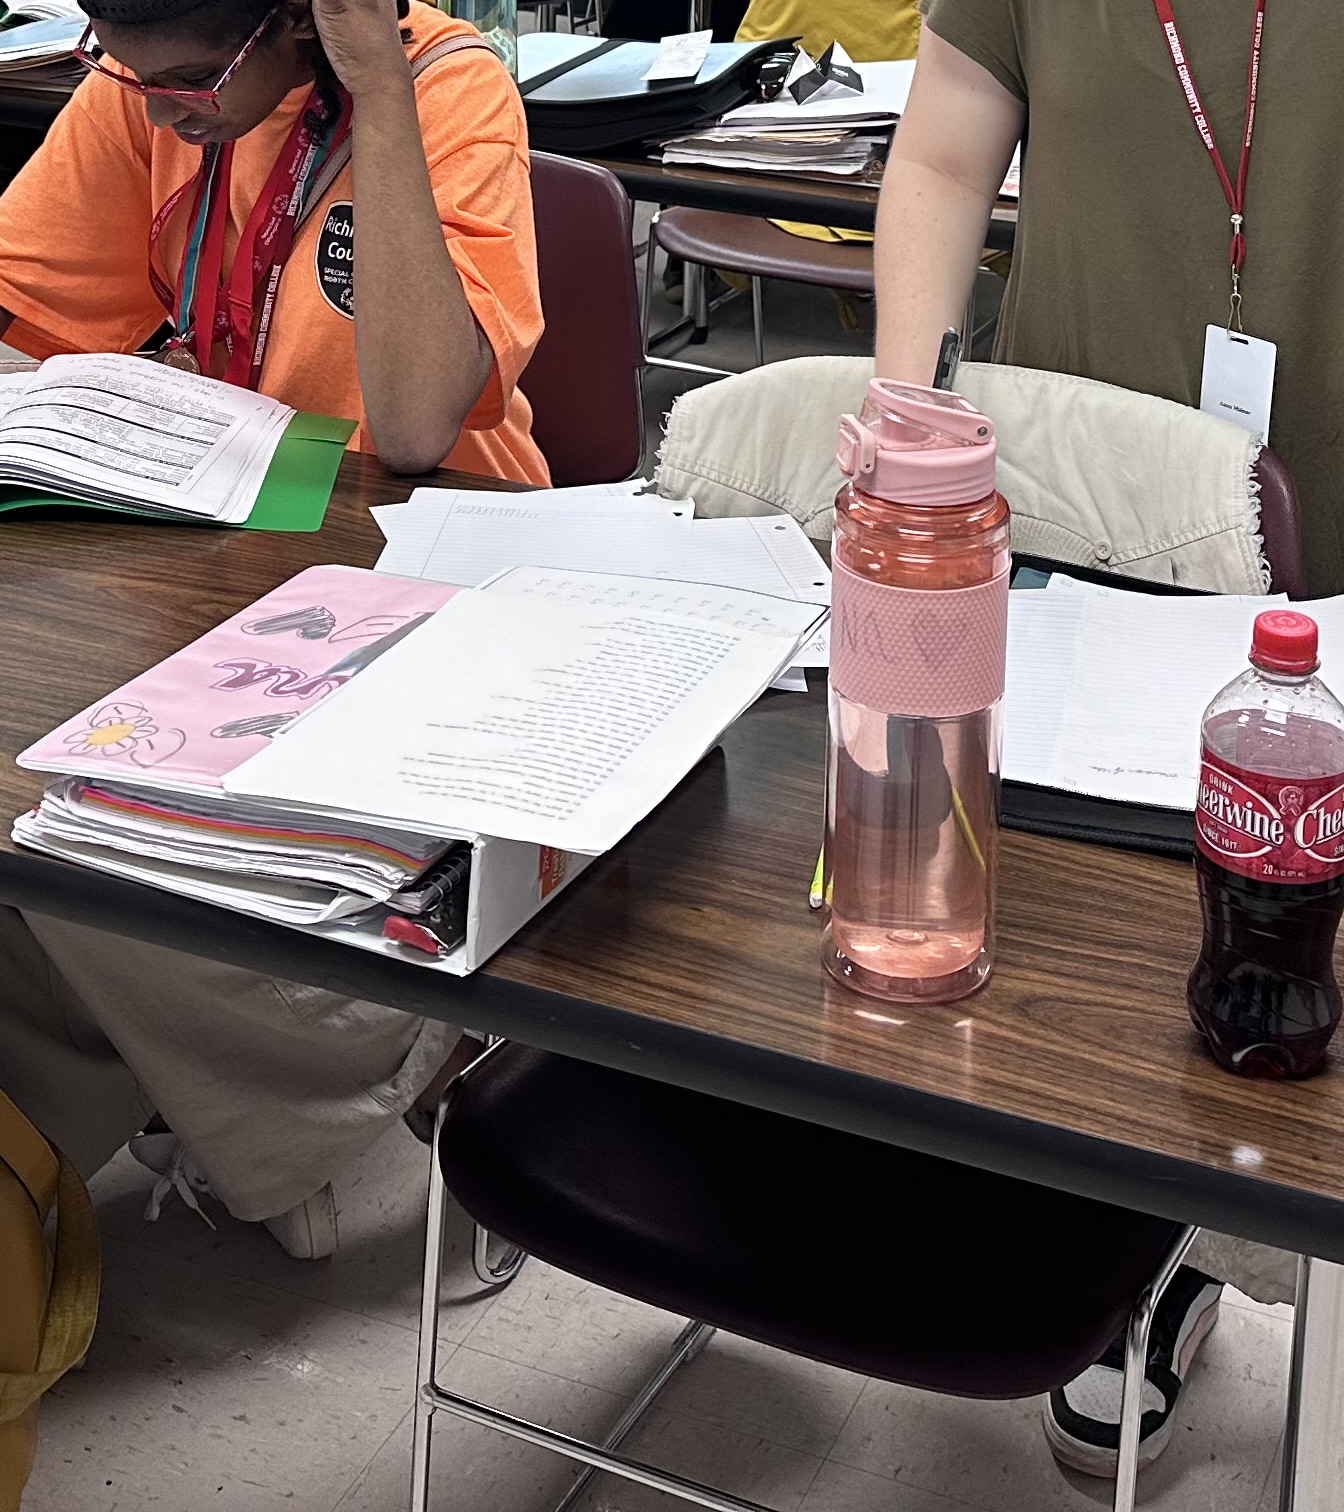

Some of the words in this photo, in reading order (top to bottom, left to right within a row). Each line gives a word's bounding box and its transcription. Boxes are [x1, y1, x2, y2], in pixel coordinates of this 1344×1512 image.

[1163, 22, 1185, 65] RICHMOND
[1175, 65, 1202, 113] COMMUNITY
[1194, 115, 1214, 150] COLLEGE
[1209, 773, 1233, 795] DRINK
[1262, 864, 1273, 875] 20
